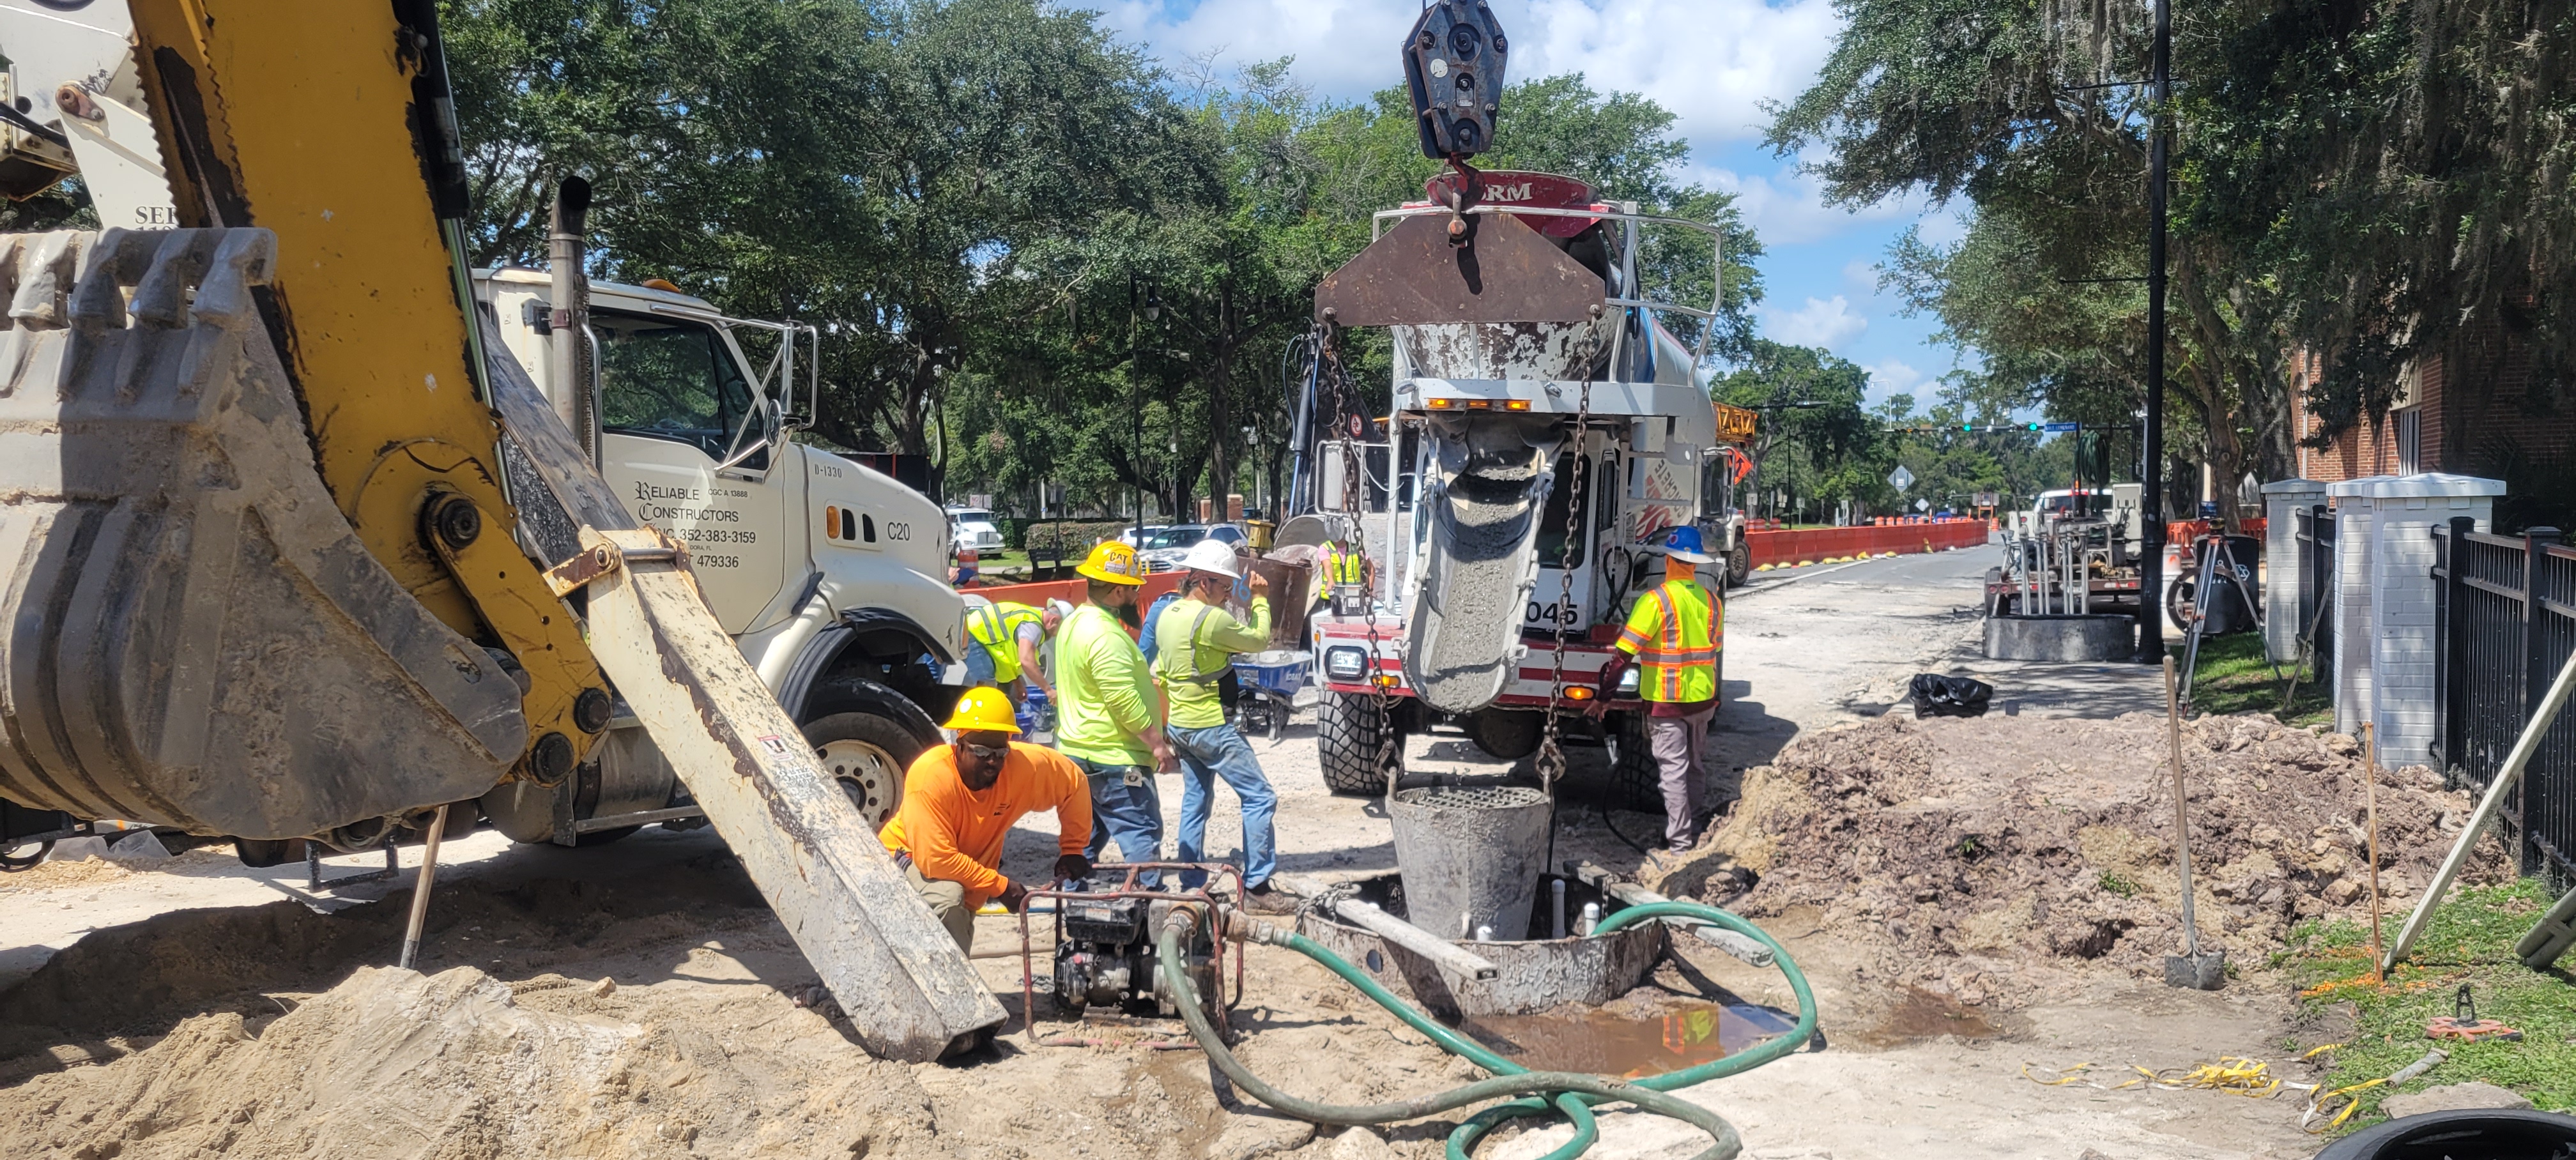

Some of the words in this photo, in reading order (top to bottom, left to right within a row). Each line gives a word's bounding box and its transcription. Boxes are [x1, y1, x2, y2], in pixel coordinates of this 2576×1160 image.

[1481, 182, 1533, 202] RM
[815, 464, 842, 478] D-1330
[634, 481, 700, 501] RELIABLE
[730, 490, 748, 498] 13888
[639, 502, 739, 523] CONSTRUCTORS
[679, 528, 756, 544] 352-383-3159
[887, 521, 910, 542] C20
[697, 554, 739, 568] 479336
[1110, 552, 1128, 565] CAT
